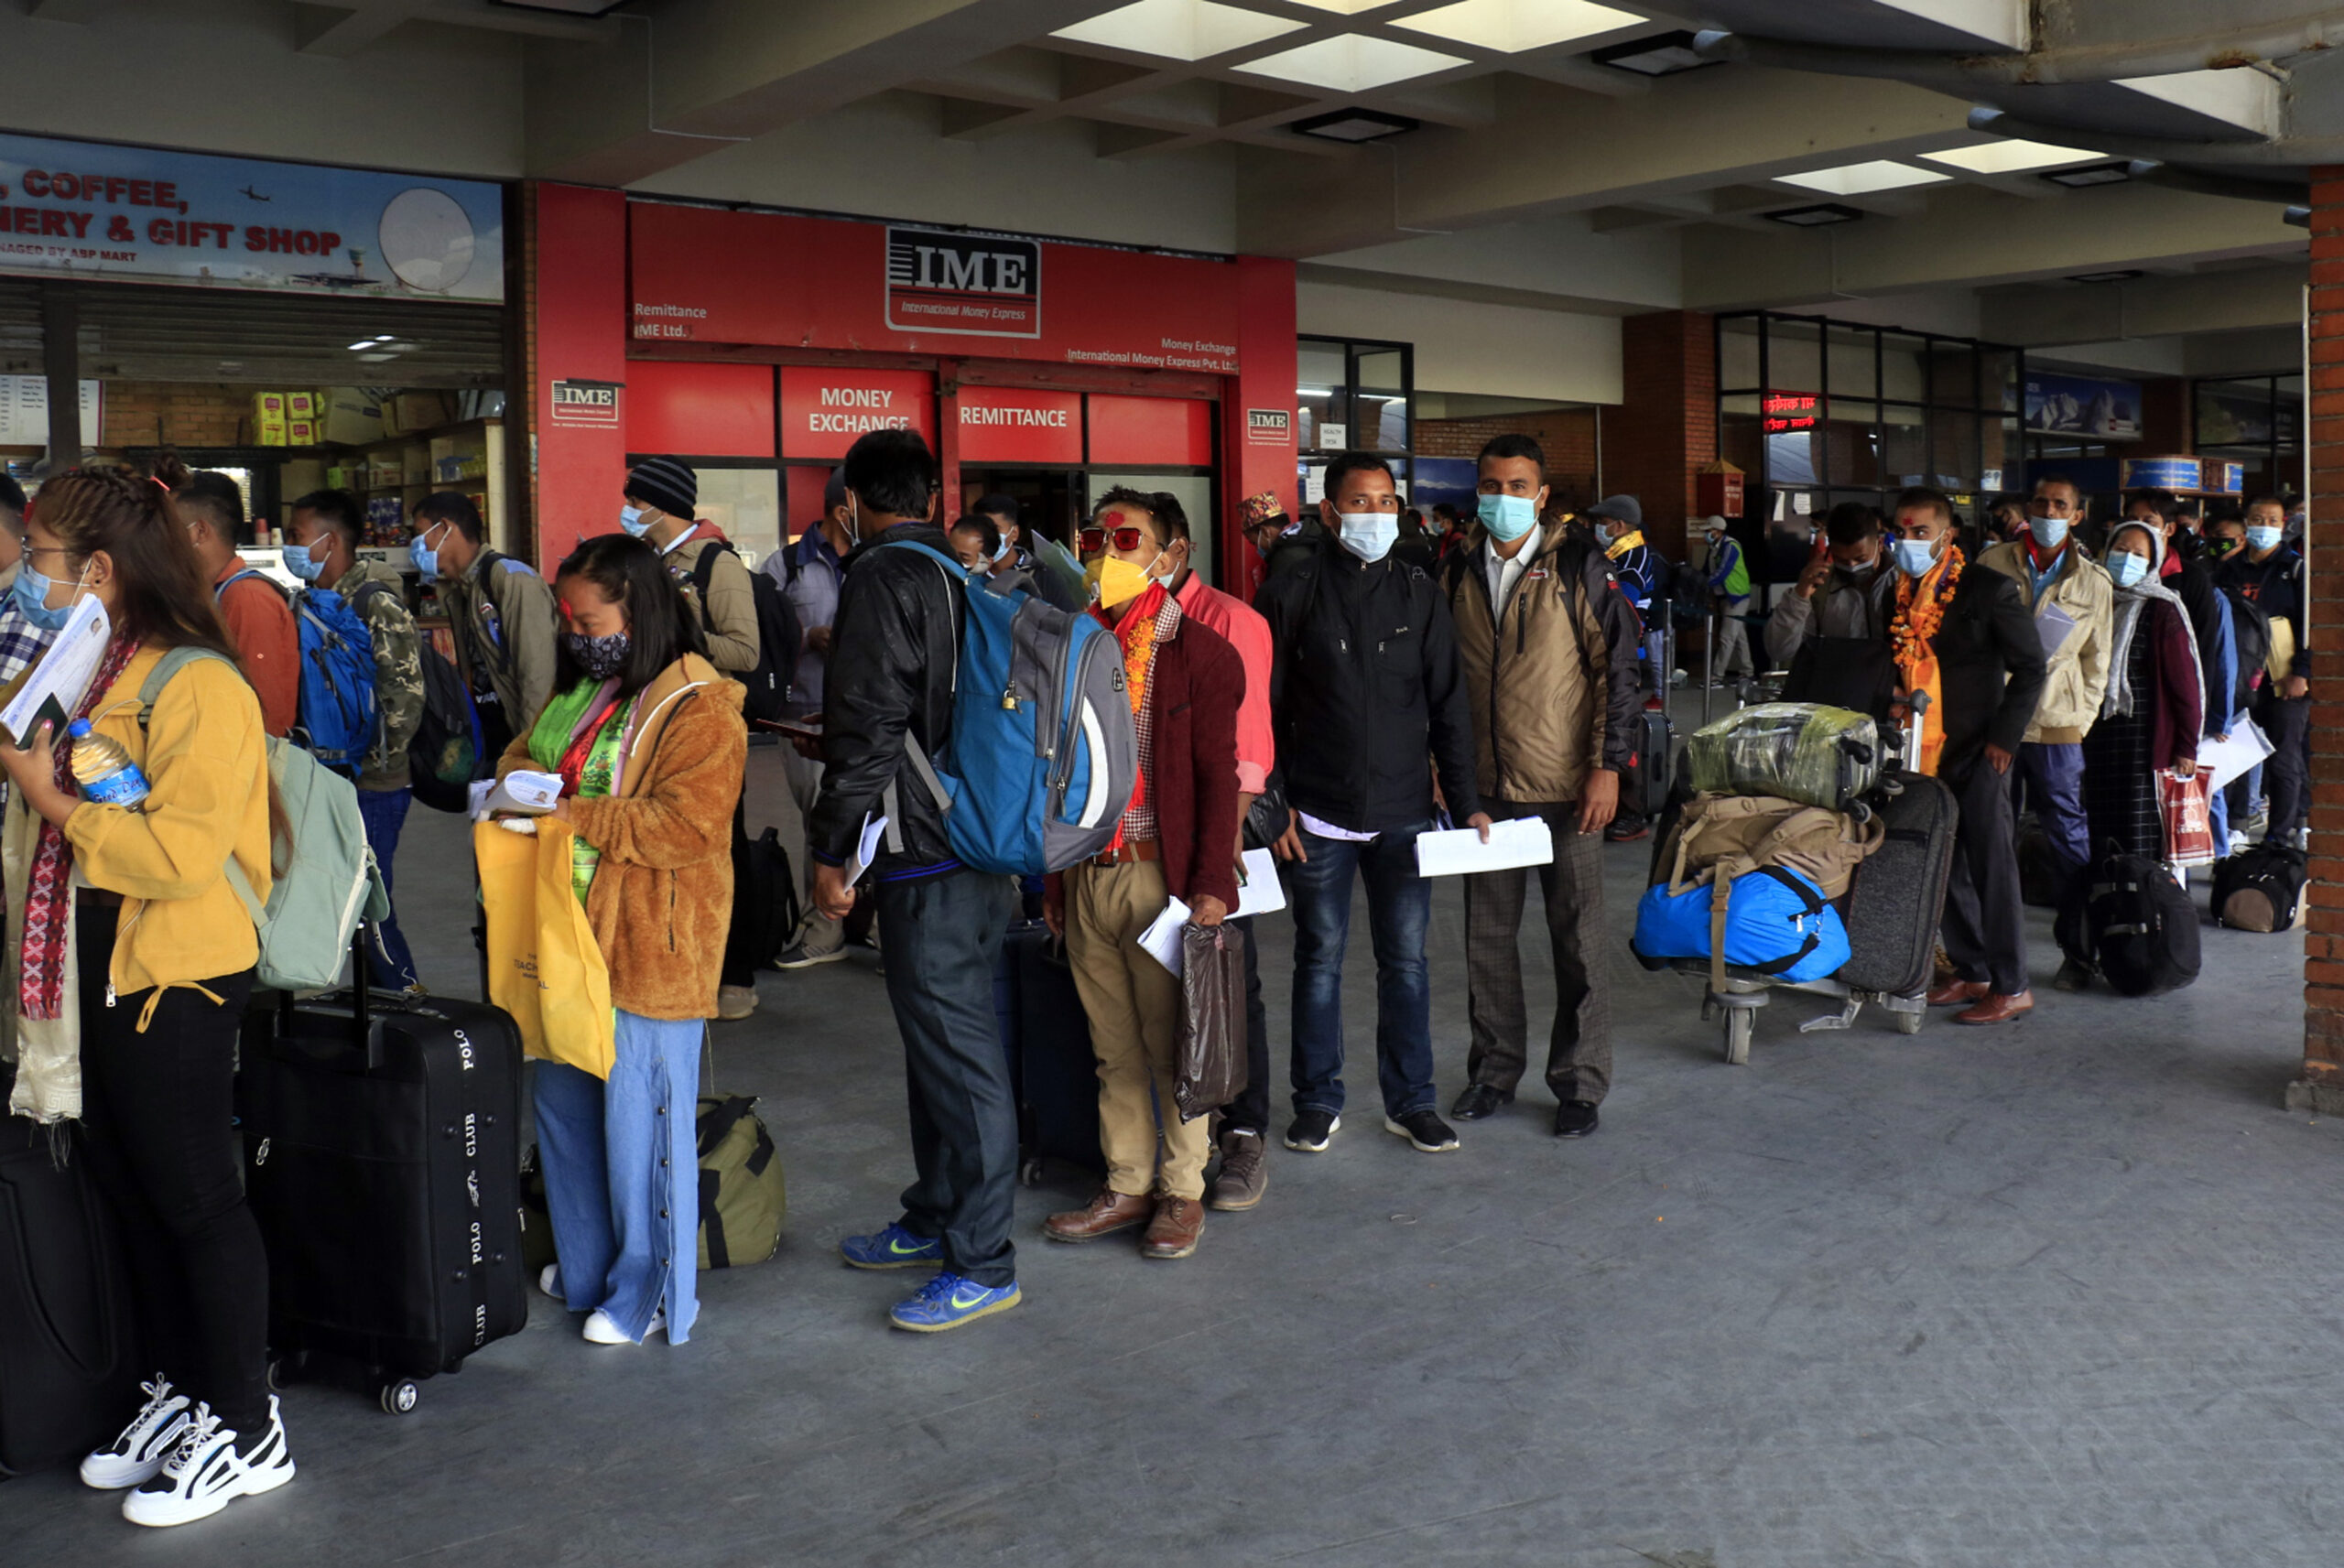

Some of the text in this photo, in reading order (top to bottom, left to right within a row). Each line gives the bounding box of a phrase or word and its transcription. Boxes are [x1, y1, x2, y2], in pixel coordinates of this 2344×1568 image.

[24, 169, 189, 215] COFFEE,
[107, 214, 135, 242] &
[148, 219, 234, 249] GIFT
[244, 225, 341, 256] SHOP
[100, 250, 137, 262] MART
[916, 245, 1026, 295] IME
[635, 303, 707, 319] Remittance
[901, 301, 1026, 320] International Money Express
[635, 323, 687, 337] IME Ltd.
[1161, 338, 1236, 357] Money Exchange
[1067, 349, 1130, 362] International
[1132, 353, 1164, 367] Money
[1166, 355, 1200, 369] Express
[563, 388, 612, 406] IME
[820, 388, 892, 408] MONEY
[960, 406, 1067, 427] REMITTANCE
[1256, 415, 1286, 428] IME
[453, 1029, 474, 1071] POLO
[465, 1112, 476, 1157] CLUB
[472, 1221, 482, 1264] POLO
[474, 1303, 486, 1346] CLUB
